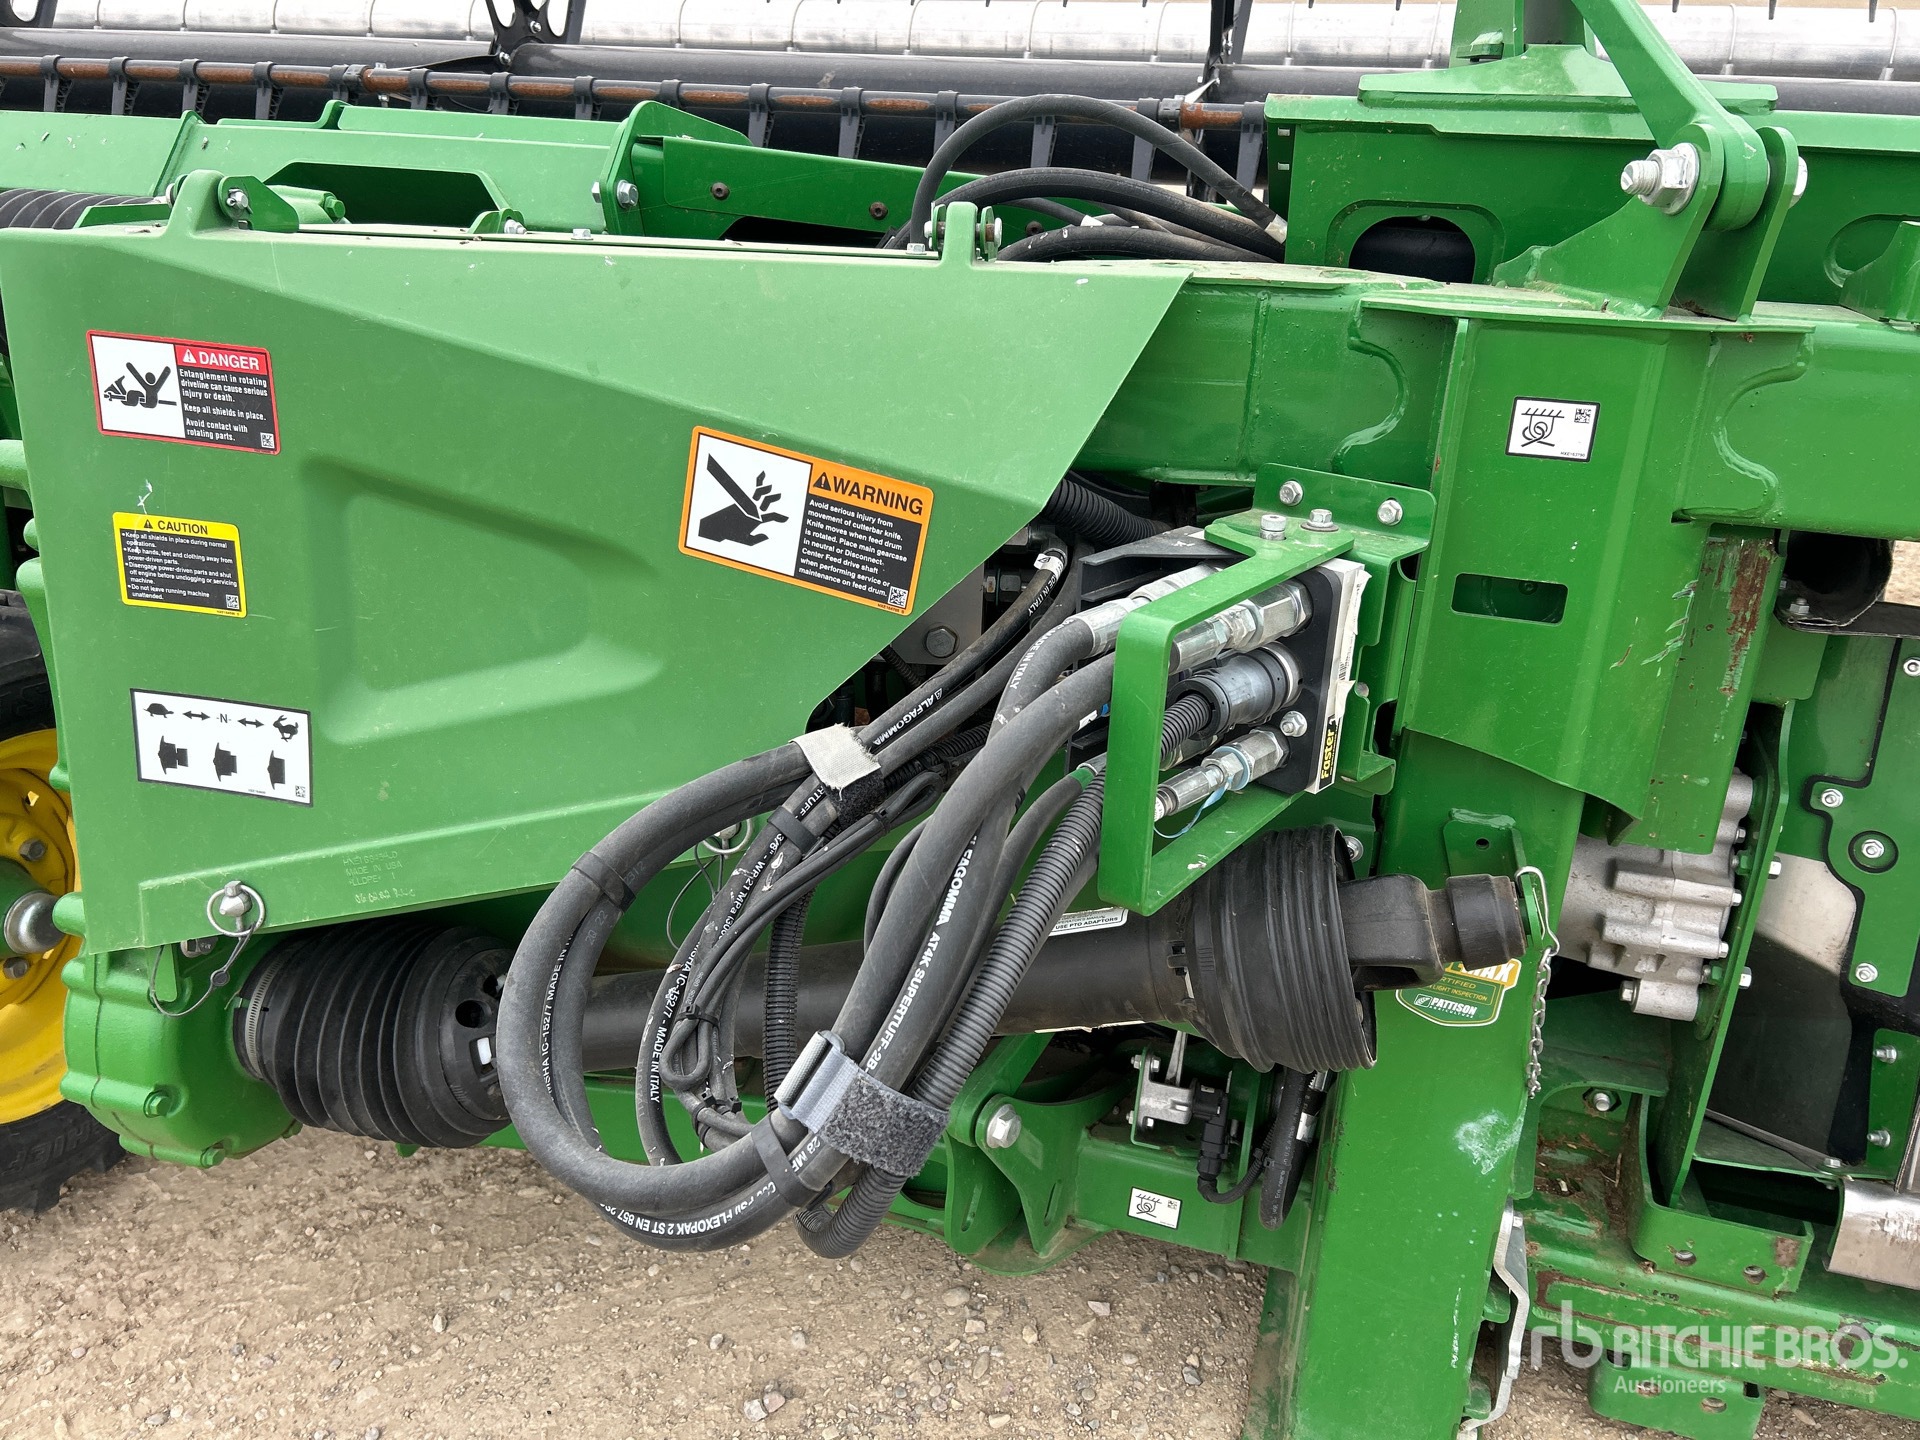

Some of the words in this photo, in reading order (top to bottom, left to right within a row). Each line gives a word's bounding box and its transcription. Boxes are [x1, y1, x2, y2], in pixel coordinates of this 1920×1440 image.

[199, 352, 259, 370] DANGER
[180, 369, 228, 382] Entanglement
[239, 376, 267, 387] rotating
[181, 379, 209, 389] driveline
[211, 383, 222, 391] can
[224, 385, 242, 393] cause
[244, 386, 267, 396] serious
[182, 389, 203, 400] injury
[213, 392, 235, 402] death.
[184, 403, 201, 414] Keep
[202, 405, 211, 414] all
[212, 406, 236, 417] shields
[246, 411, 267, 421] place.
[186, 418, 205, 428] Avoid
[207, 421, 231, 431] contact
[233, 424, 247, 433] with
[187, 429, 213, 440] rotating
[216, 432, 235, 441] parts.
[833, 476, 923, 516] WARNING
[810, 499, 829, 511] Avoid
[830, 505, 855, 517] serious
[856, 511, 876, 525] injury
[877, 515, 893, 528] from
[158, 520, 208, 534] CAUTION
[808, 510, 843, 524] movement
[844, 517, 851, 525] of
[853, 520, 883, 535] cutterbar
[884, 528, 903, 541] knife.
[126, 540, 156, 548] operations.
[190, 539, 208, 547] during
[806, 519, 824, 531] Knife
[825, 525, 848, 536] moves
[849, 531, 867, 541] when
[868, 534, 883, 546] feed
[884, 539, 902, 551] drum
[803, 538, 809, 546] in
[810, 540, 835, 552] neutral
[837, 547, 843, 555] or
[845, 548, 883, 566] Disconnect.
[813, 531, 838, 543] rotated.
[839, 536, 858, 548] Place
[859, 542, 875, 553] main
[877, 547, 908, 563] gearcase
[128, 555, 163, 564] power-driven
[164, 558, 179, 566] parts.
[184, 553, 205, 561] clothing
[206, 556, 219, 564] away
[802, 548, 824, 560] Center
[826, 554, 842, 564] Feed
[843, 558, 860, 569] drive
[861, 563, 879, 574] shaft
[129, 562, 157, 571] Disengage
[158, 565, 193, 574] power-driven
[800, 558, 818, 568] when
[819, 562, 856, 579] performing
[857, 572, 881, 585] service
[883, 579, 891, 587] or
[176, 575, 205, 583] unclogging
[213, 579, 237, 587] servicing
[799, 566, 841, 582] maintenance
[842, 579, 851, 587] on
[852, 581, 867, 592] feed
[868, 585, 887, 597] drum.
[132, 592, 164, 600] unattended.
[166, 588, 186, 596] running
[1028, 594, 1044, 617] ITALY
[1010, 663, 1028, 690] ITALY
[873, 695, 935, 746] ALFAGOMMA
[1320, 729, 1335, 780] Faster
[386, 861, 403, 870] USA
[730, 891, 747, 914] MPa
[1084, 917, 1118, 925] ADAPTORS
[919, 931, 941, 969] AT4K
[1433, 985, 1451, 994] LIGHT
[1451, 988, 1488, 1001] INSPECTION
[541, 1005, 553, 1056] IC-152/7
[547, 963, 562, 1001] MADE
[1431, 997, 1478, 1015] PATTISON
[652, 1026, 668, 1060] MADE
[650, 1074, 661, 1103] ITALY
[617, 1206, 635, 1227] 857
[635, 1216, 650, 1233] EN
[676, 1210, 733, 1236] FLEXOPAK
[651, 1220, 666, 1235] ST
